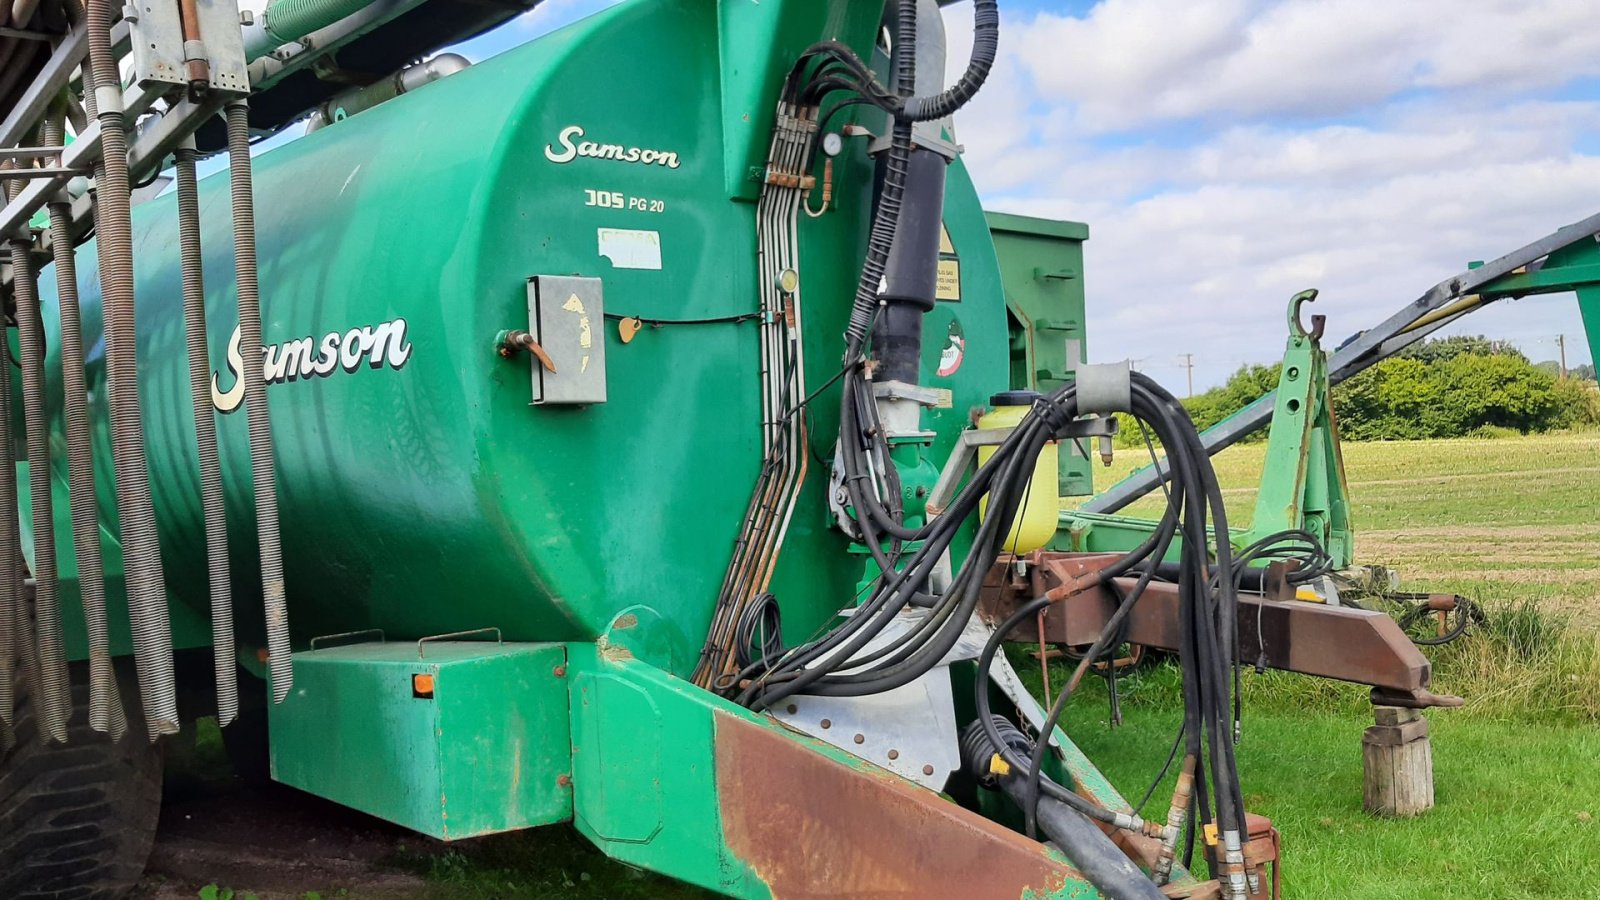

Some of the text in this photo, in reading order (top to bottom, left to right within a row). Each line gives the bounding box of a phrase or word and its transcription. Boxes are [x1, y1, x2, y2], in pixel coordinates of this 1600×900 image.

[544, 125, 681, 169] Samson
[628, 197, 647, 211] PG
[649, 200, 665, 213] 20
[211, 318, 412, 414] Samson
